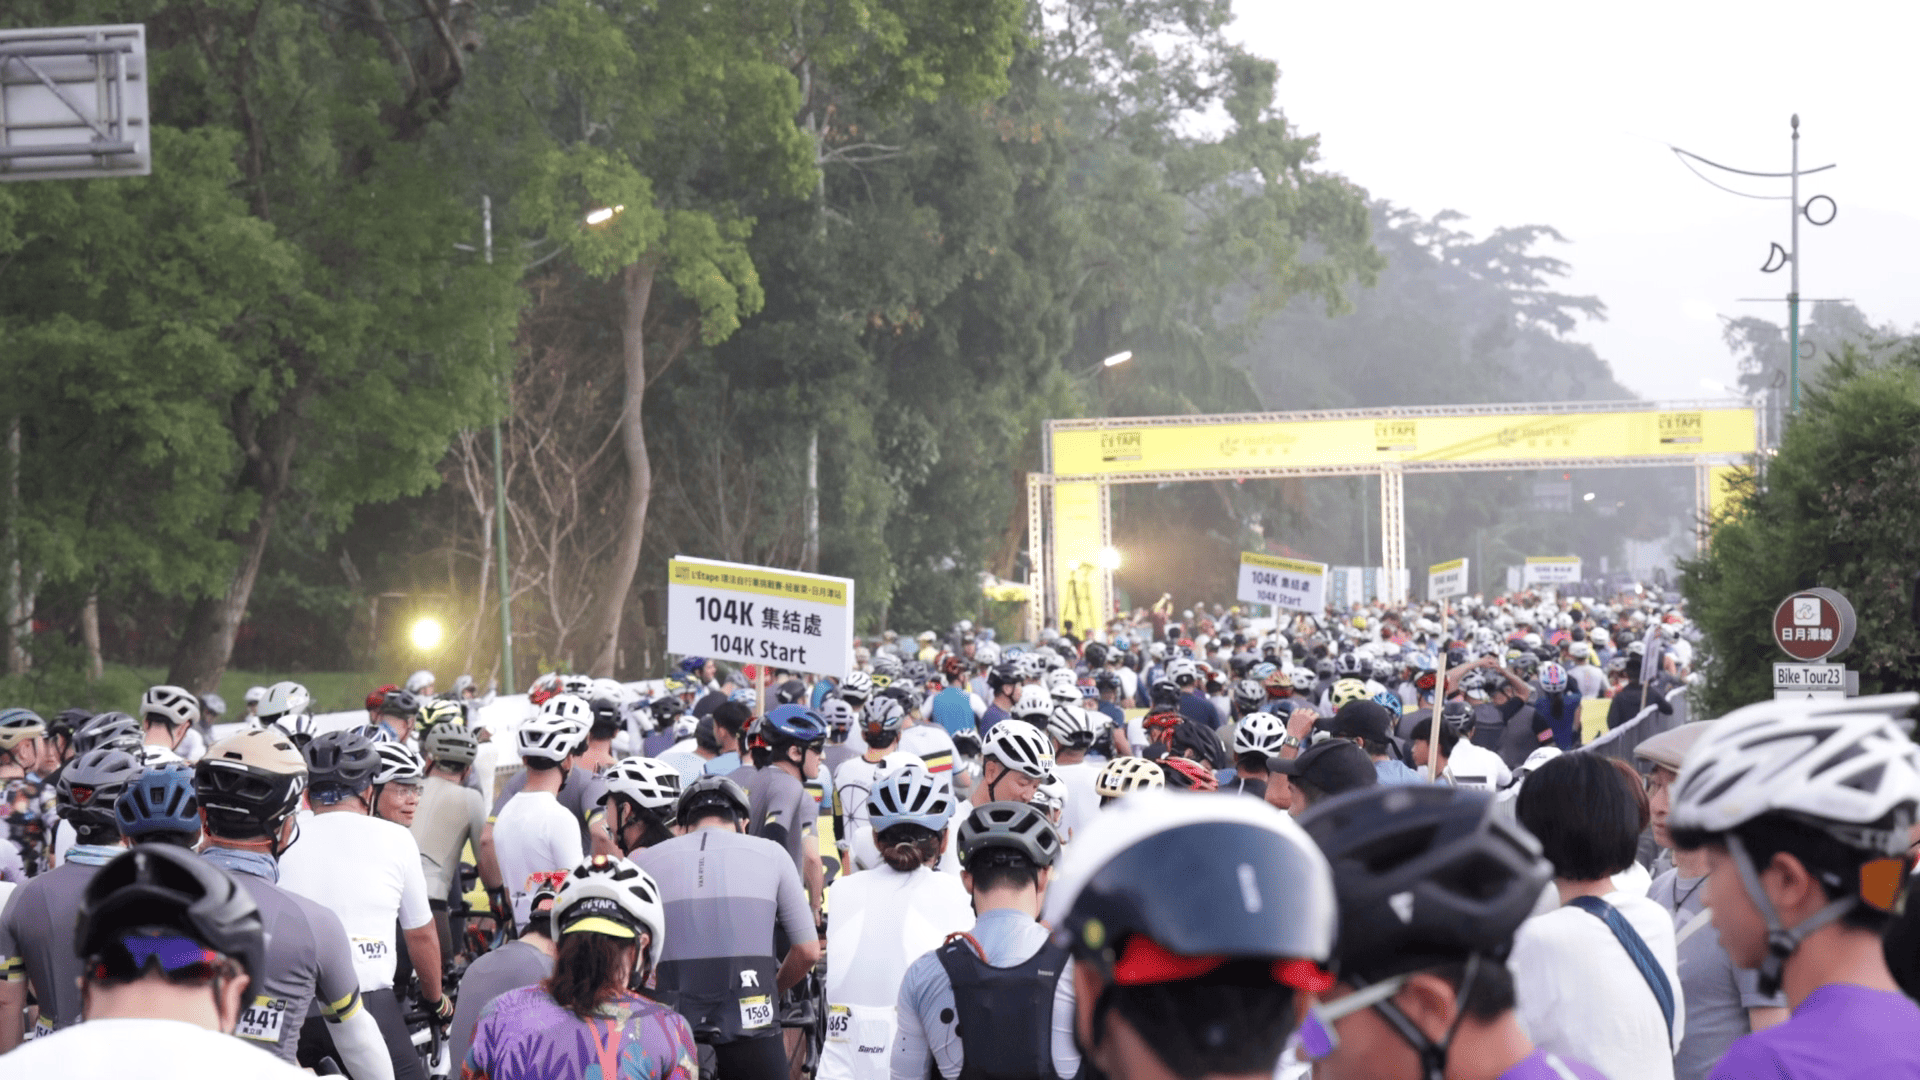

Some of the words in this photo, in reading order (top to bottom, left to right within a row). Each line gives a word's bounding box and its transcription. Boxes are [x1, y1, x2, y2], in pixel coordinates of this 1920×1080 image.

[1252, 571, 1278, 587] 104K
[696, 596, 754, 627] 104K
[761, 606, 822, 637] 集結處
[711, 634, 754, 657] 104K
[760, 640, 806, 665] Start
[1778, 668, 1800, 684] Bike
[1803, 669, 1840, 684] Tour23
[745, 1005, 770, 1020] 1568
[858, 1045, 885, 1054] Santini
